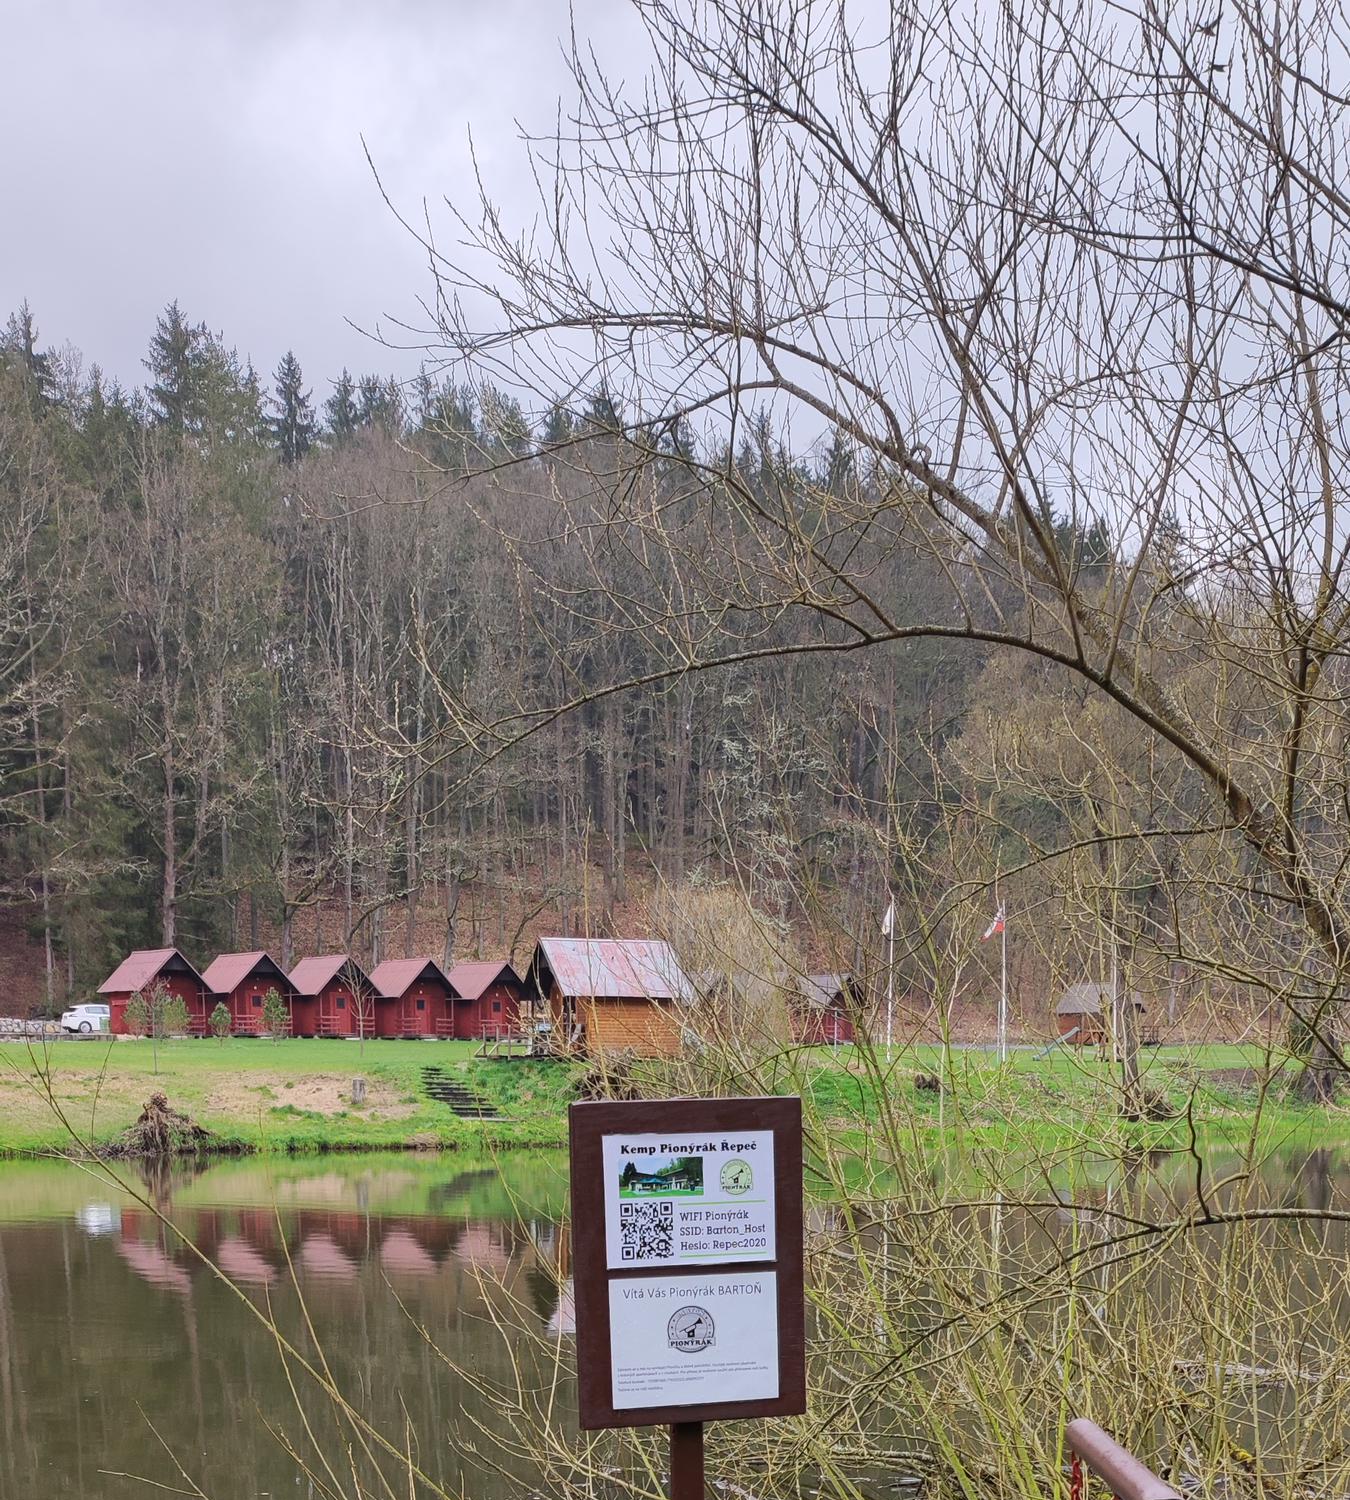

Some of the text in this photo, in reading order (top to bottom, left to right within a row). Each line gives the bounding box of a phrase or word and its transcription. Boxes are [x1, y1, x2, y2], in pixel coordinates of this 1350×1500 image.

[621, 1139, 757, 1156] Kemp Pionýrák Řepeč
[679, 1209, 749, 1222] WIFI Pionýrák
[679, 1223, 766, 1236] SSID: Barton_Host
[681, 1237, 767, 1252] Heslo: Repec2020
[623, 1281, 762, 1299] Vítá Vás Pionýrák BARTOŇ
